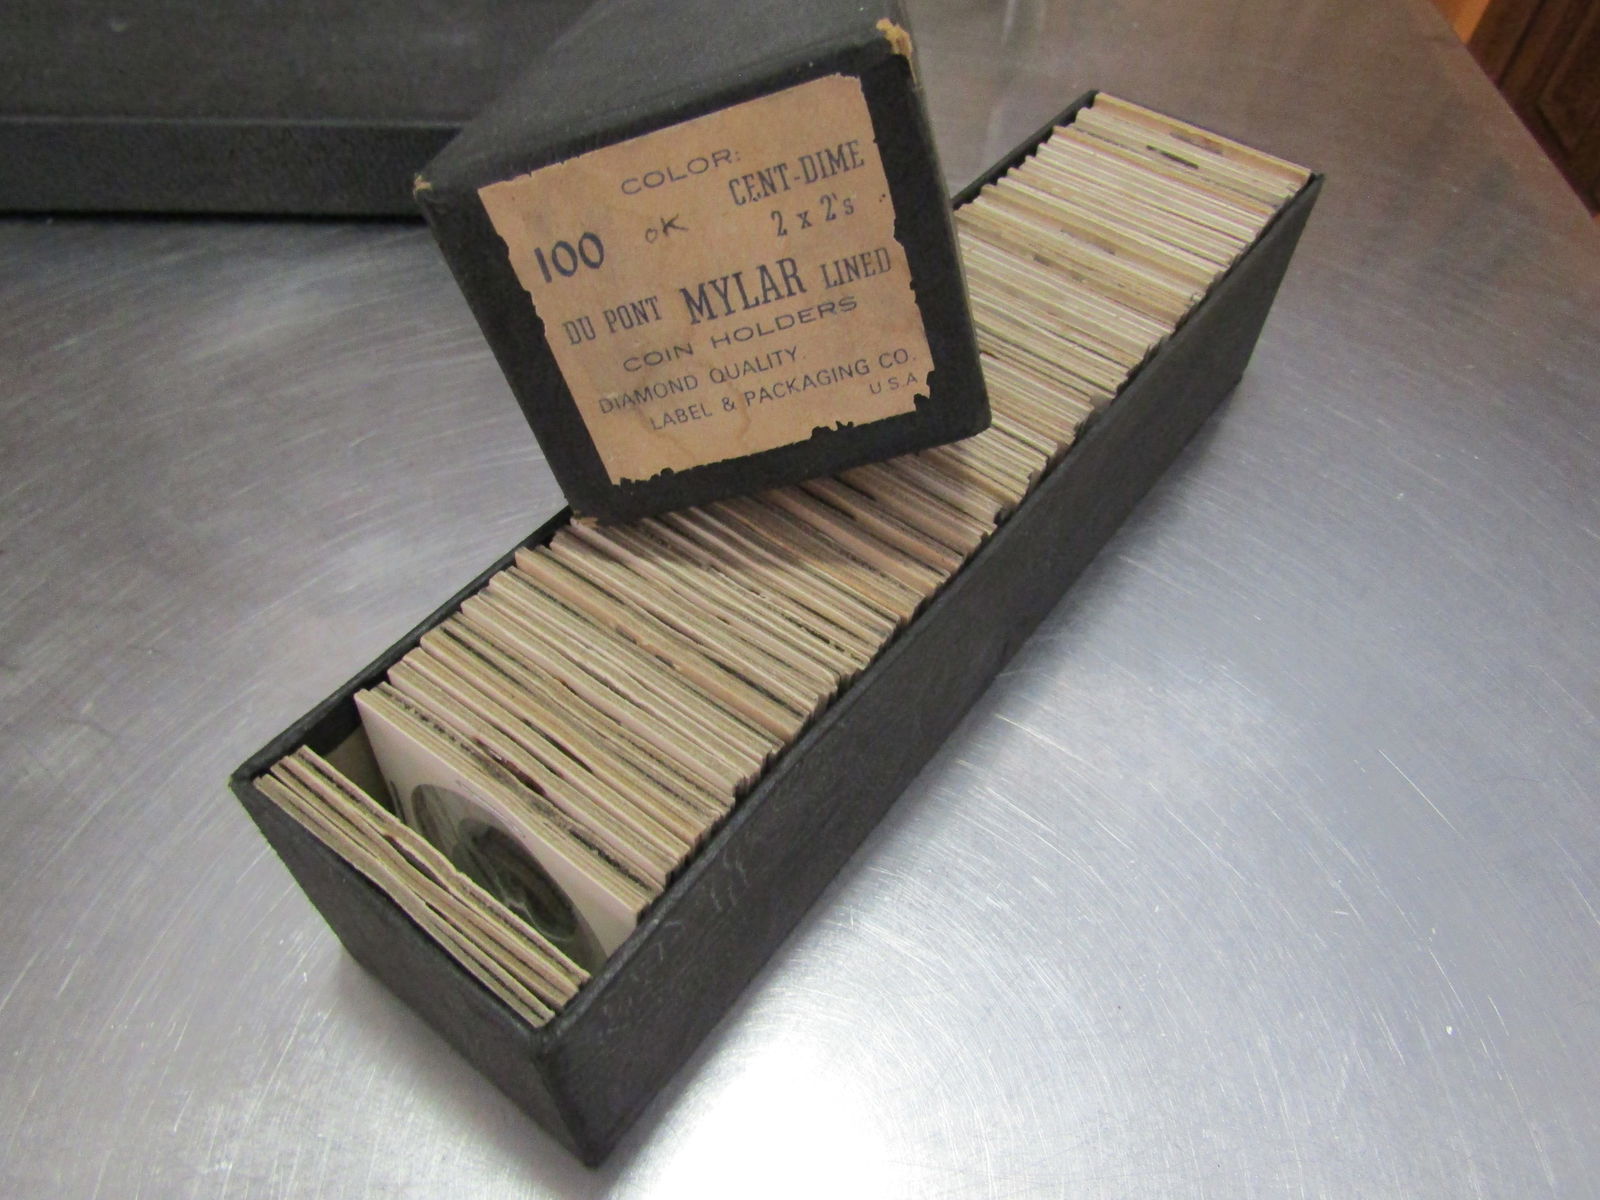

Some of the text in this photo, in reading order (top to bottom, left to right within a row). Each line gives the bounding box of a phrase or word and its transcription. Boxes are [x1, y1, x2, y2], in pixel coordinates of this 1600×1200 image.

[620, 148, 741, 196] COLOR:
[728, 139, 865, 207] CENT-DIME
[770, 211, 788, 237] 2
[820, 192, 855, 223] 2's
[534, 231, 606, 283] 100
[562, 246, 892, 346] DU PONT MYLAR LINED
[622, 295, 858, 373] COIN HOLDERS
[598, 375, 698, 415] DIAMOND
[649, 401, 713, 431] LABEL
[722, 396, 736, 412] &
[744, 359, 870, 408] PACKAGING
